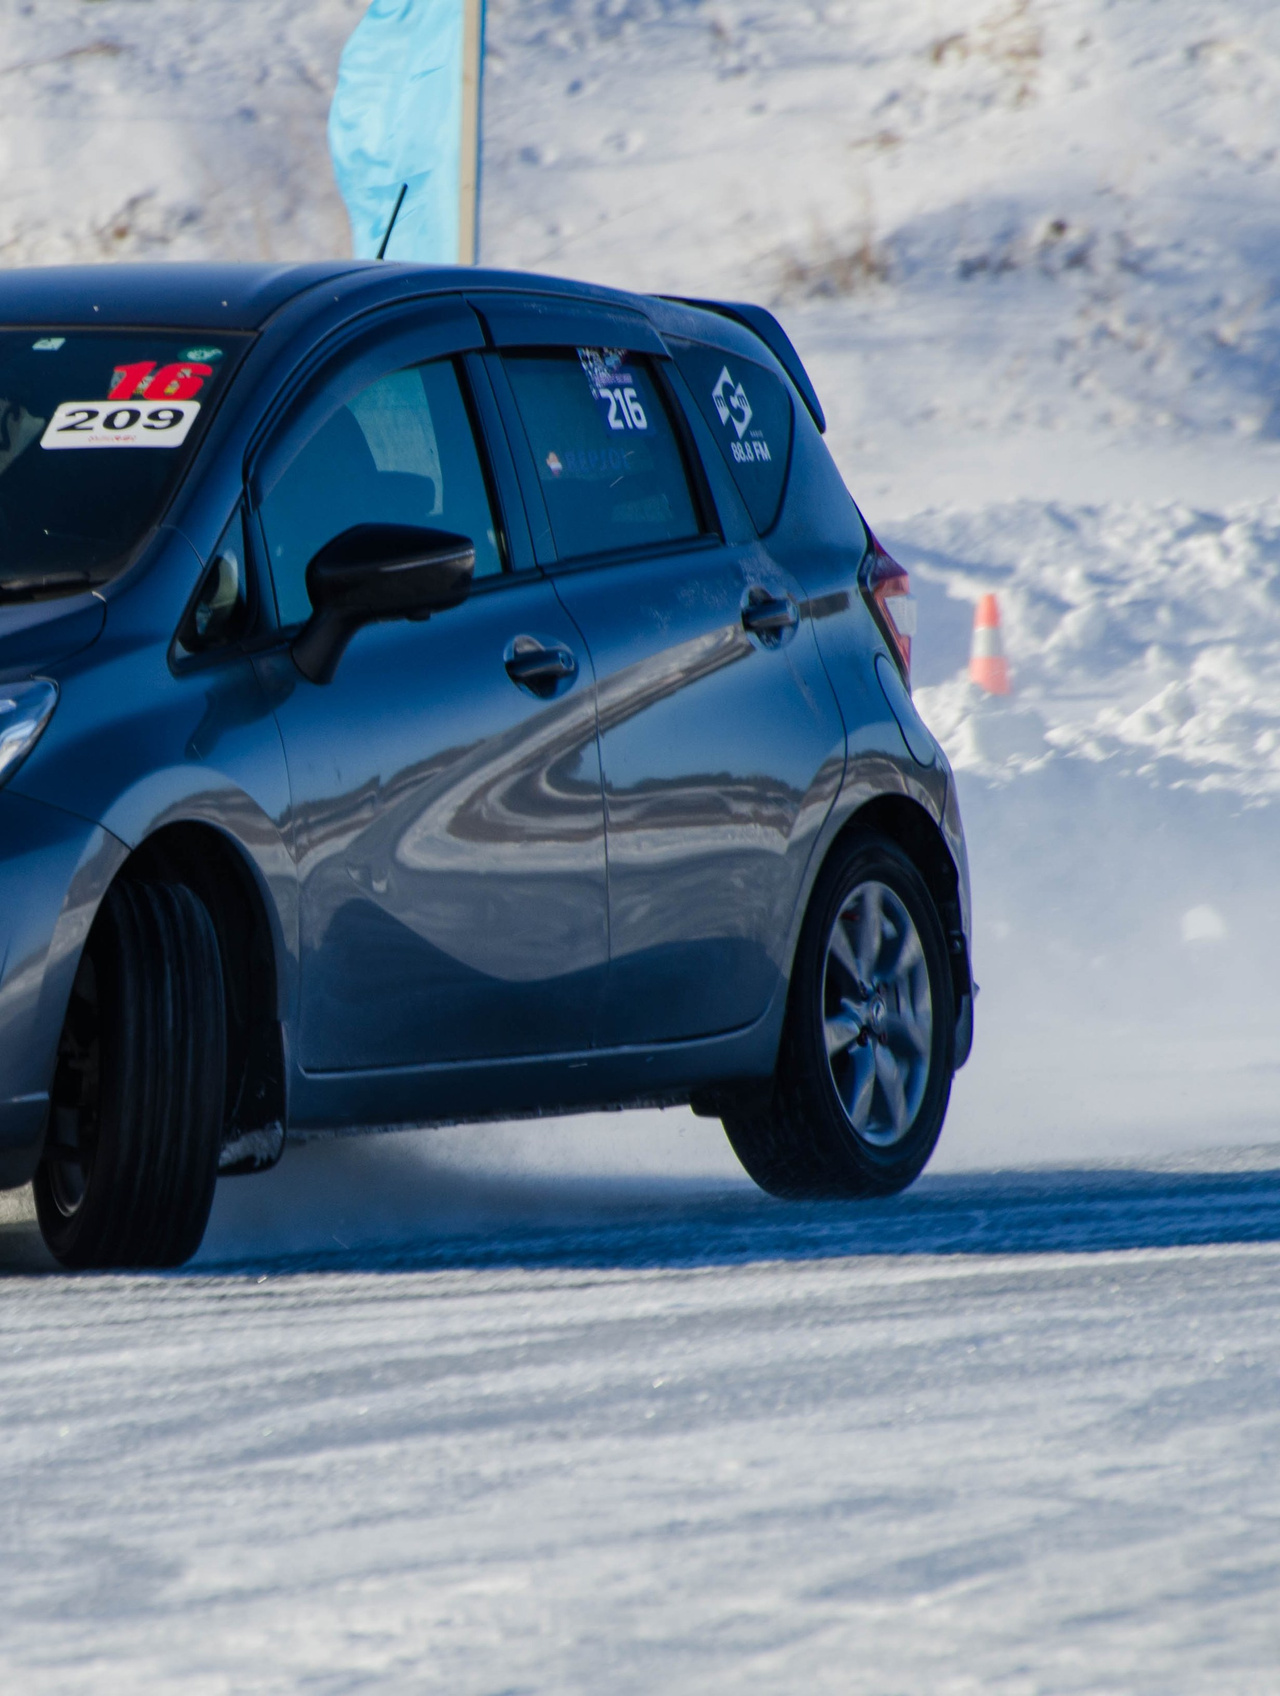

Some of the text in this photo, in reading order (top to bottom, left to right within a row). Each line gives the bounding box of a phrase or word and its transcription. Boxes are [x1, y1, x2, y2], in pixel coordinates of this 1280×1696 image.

[107, 361, 213, 401] 16
[57, 408, 185, 433] 209
[599, 387, 647, 430] 216
[751, 440, 772, 462] FM
